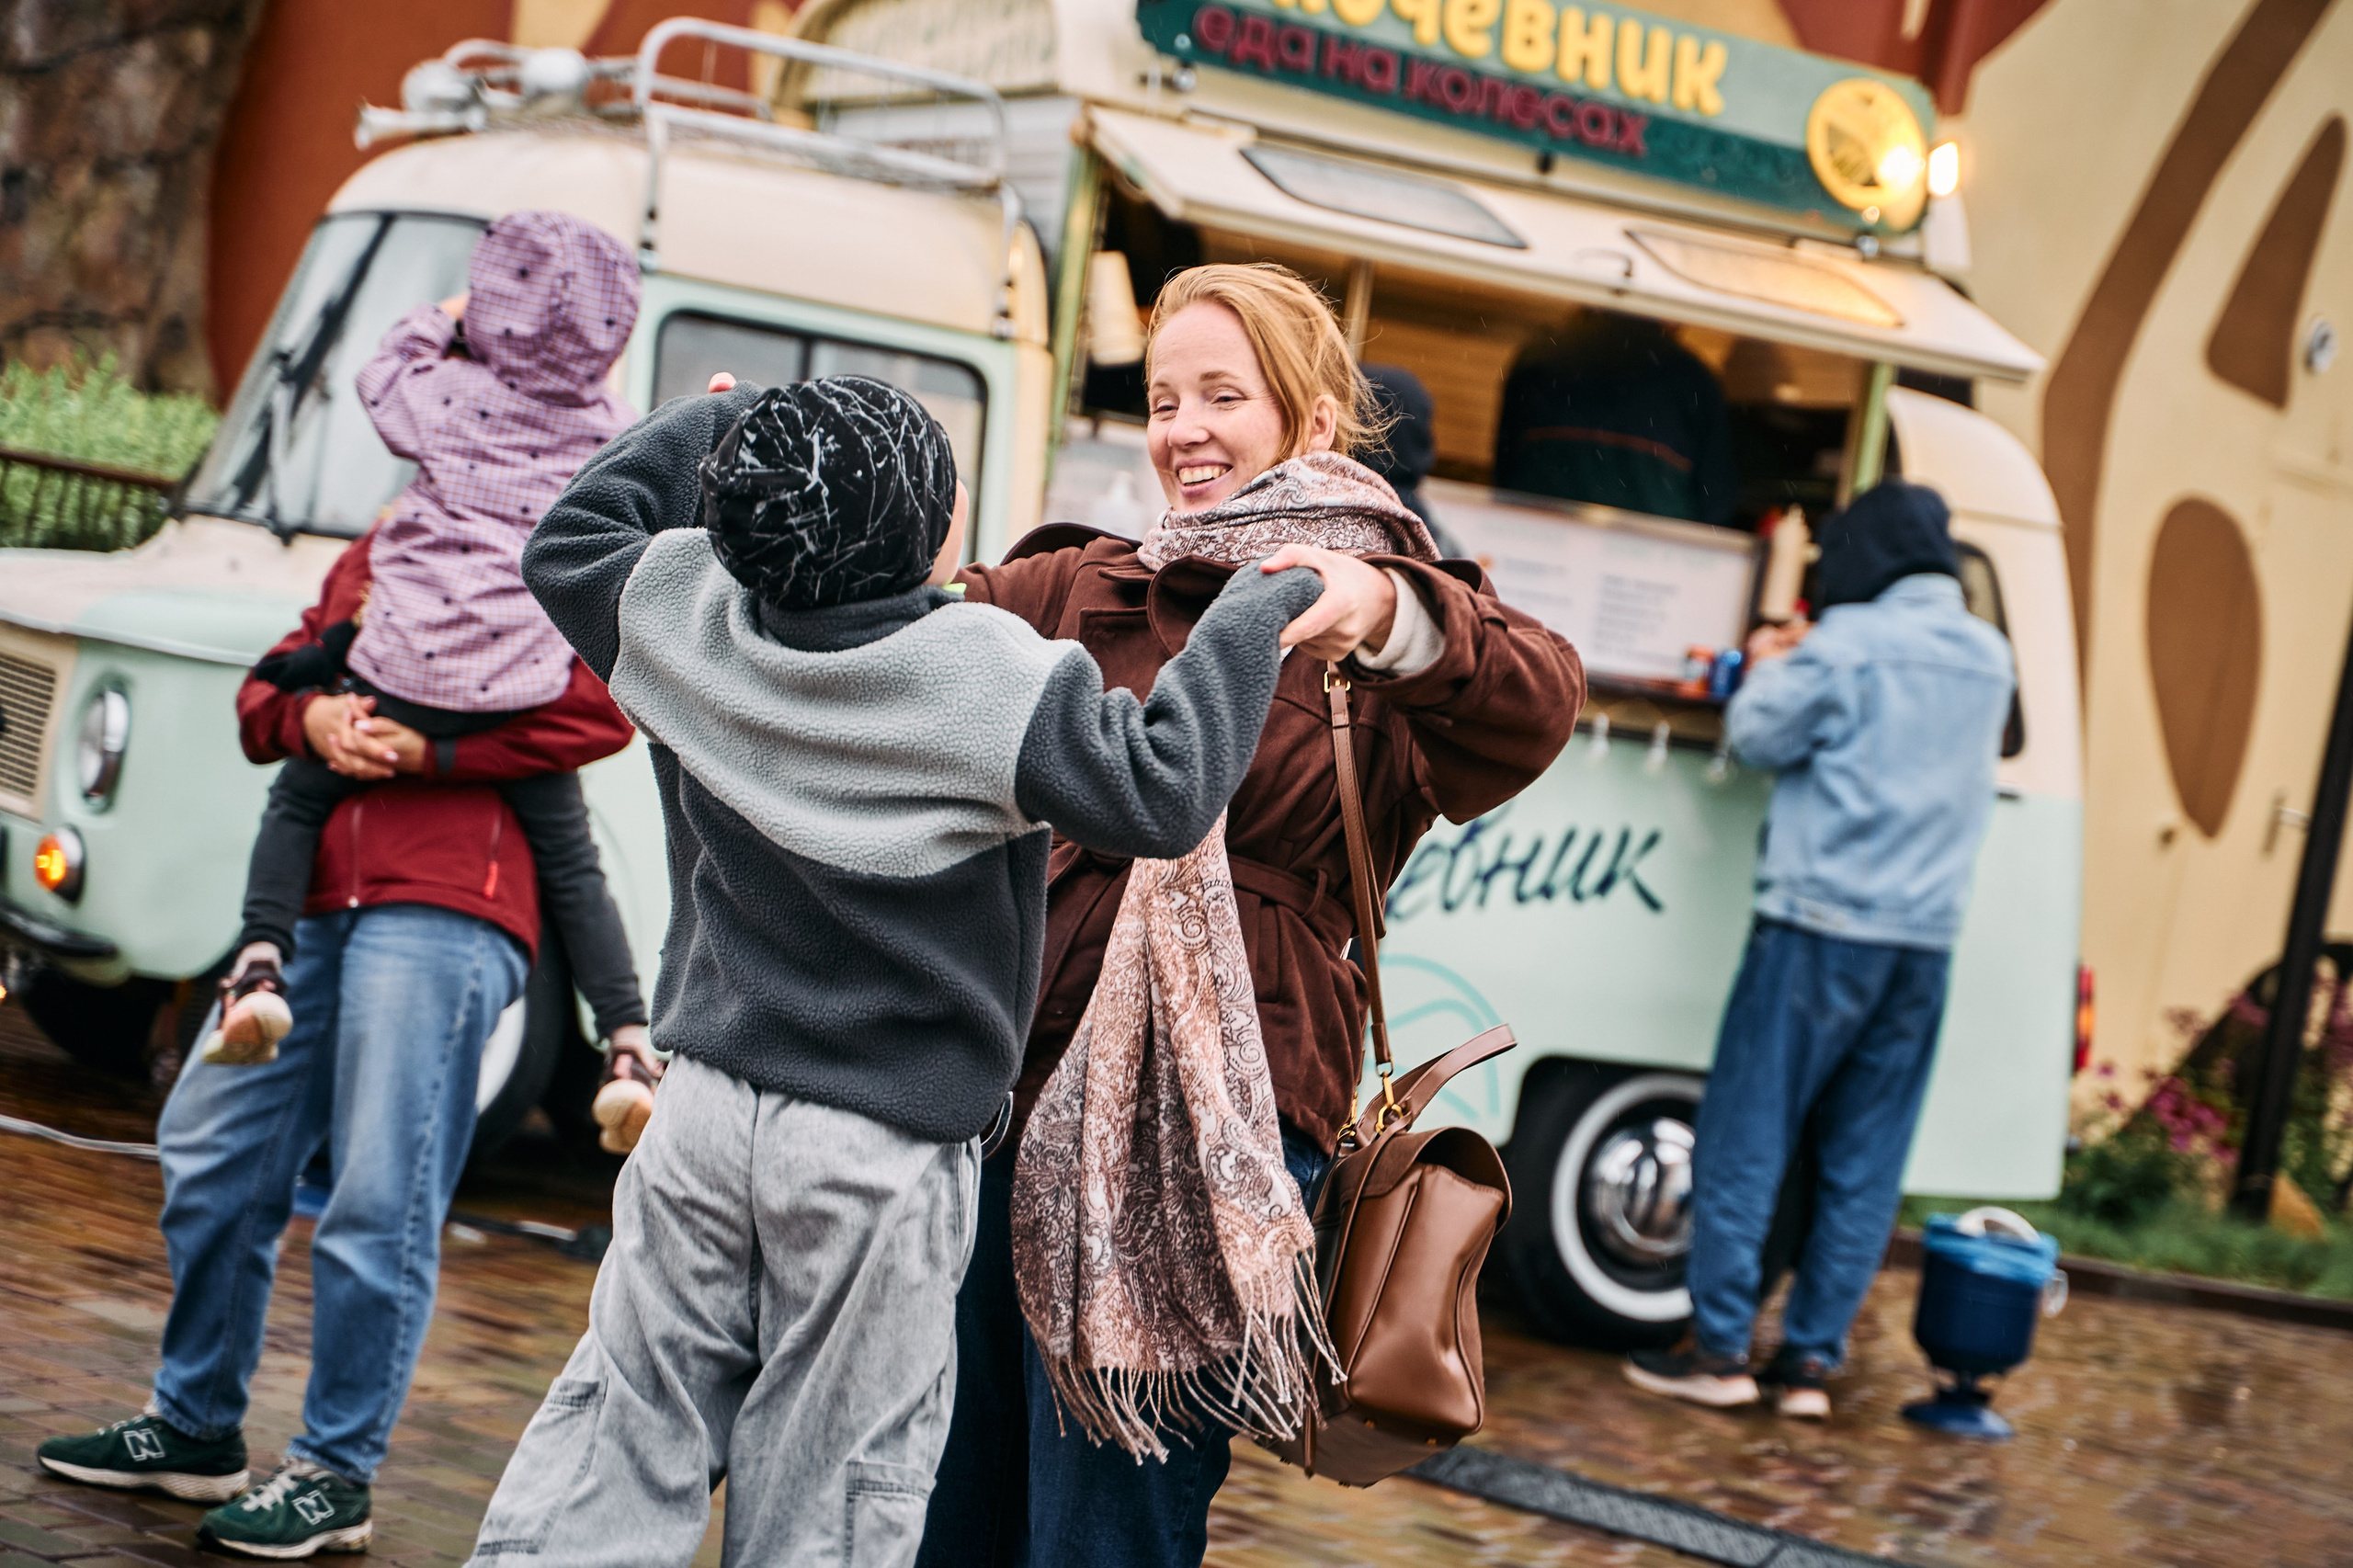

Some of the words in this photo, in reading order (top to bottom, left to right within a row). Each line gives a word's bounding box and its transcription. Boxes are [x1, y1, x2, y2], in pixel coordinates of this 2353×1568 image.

[1270, 0, 1728, 117] чевник
[1322, 35, 1400, 94] на
[1401, 57, 1649, 156] колесах
[1383, 797, 1663, 920] евник
[123, 1428, 165, 1461] N
[291, 1489, 335, 1526] N
